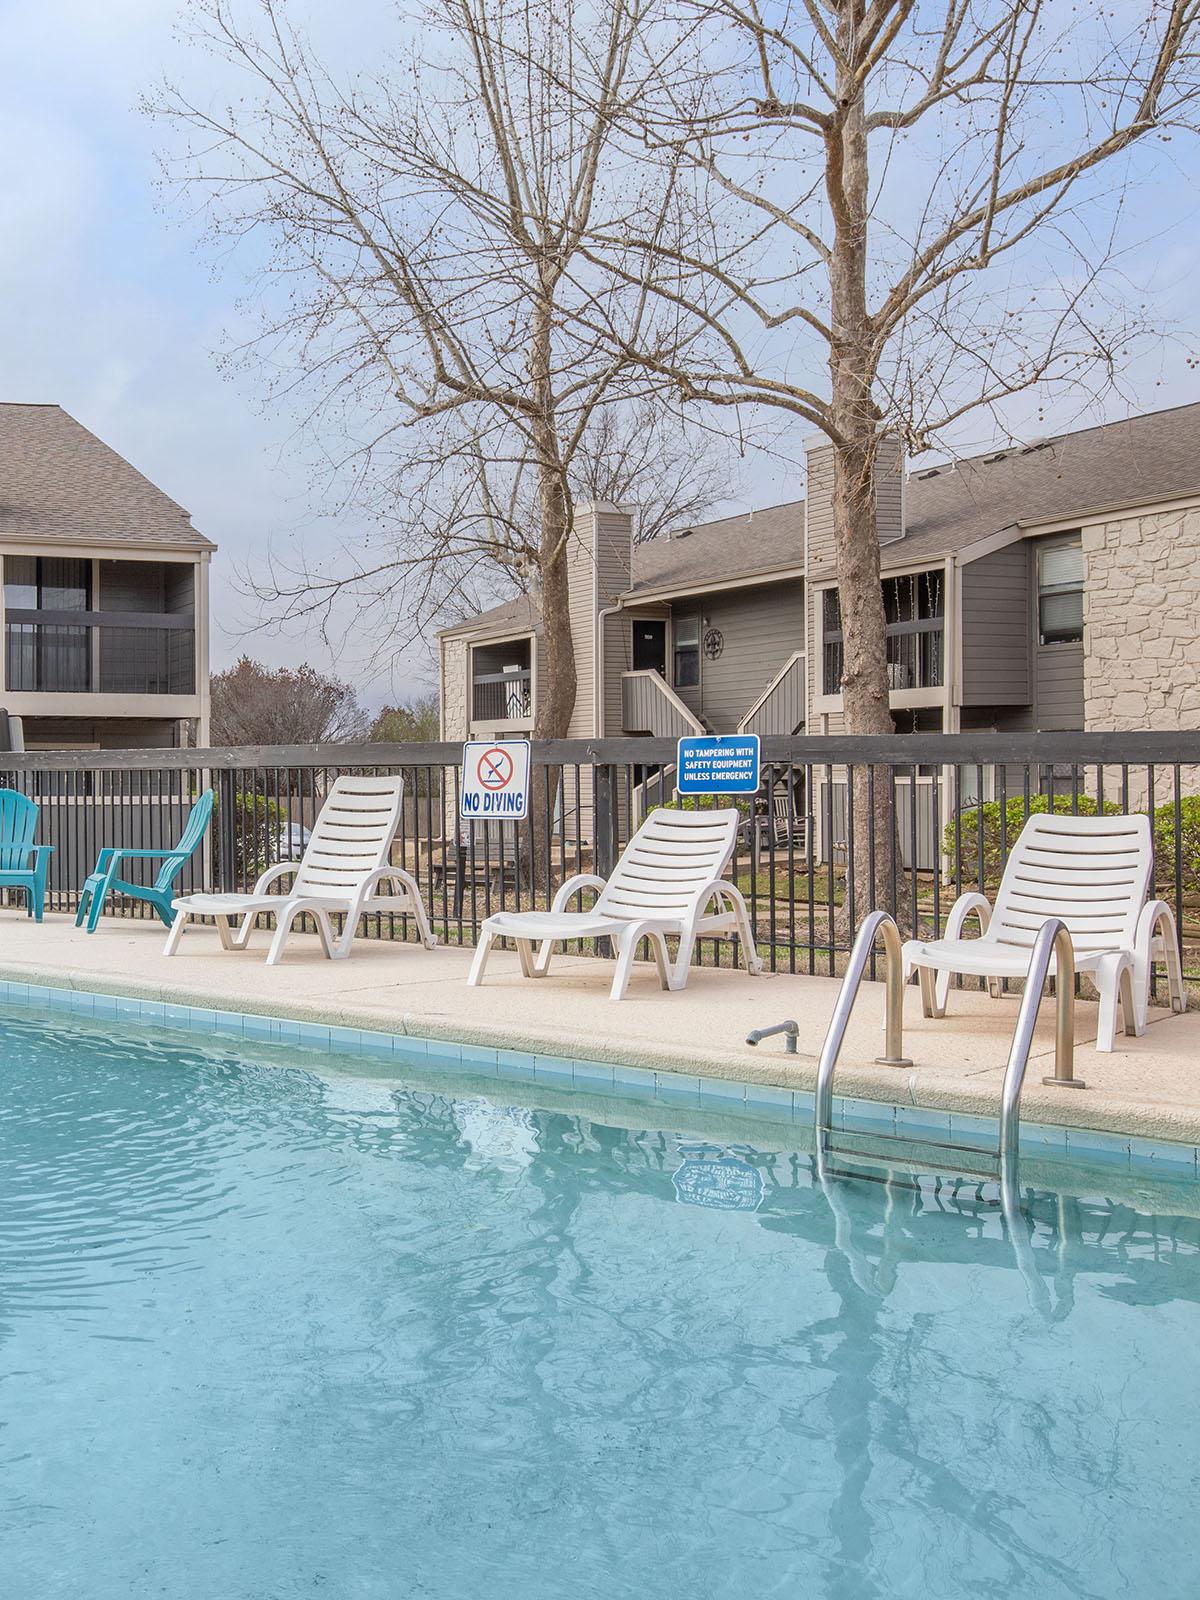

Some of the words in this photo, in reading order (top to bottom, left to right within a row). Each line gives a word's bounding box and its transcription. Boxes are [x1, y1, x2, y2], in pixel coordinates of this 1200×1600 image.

[684, 749, 694, 758] NO
[696, 748, 735, 758] TAMPERING
[736, 747, 754, 757] WITH
[685, 760, 711, 770] SAFETY
[712, 759, 753, 769] EQUIPMENT
[684, 772, 710, 781] UNLESS
[711, 771, 753, 781] EMERGENCY
[464, 792, 480, 812] NO
[483, 792, 524, 812] DIVING
